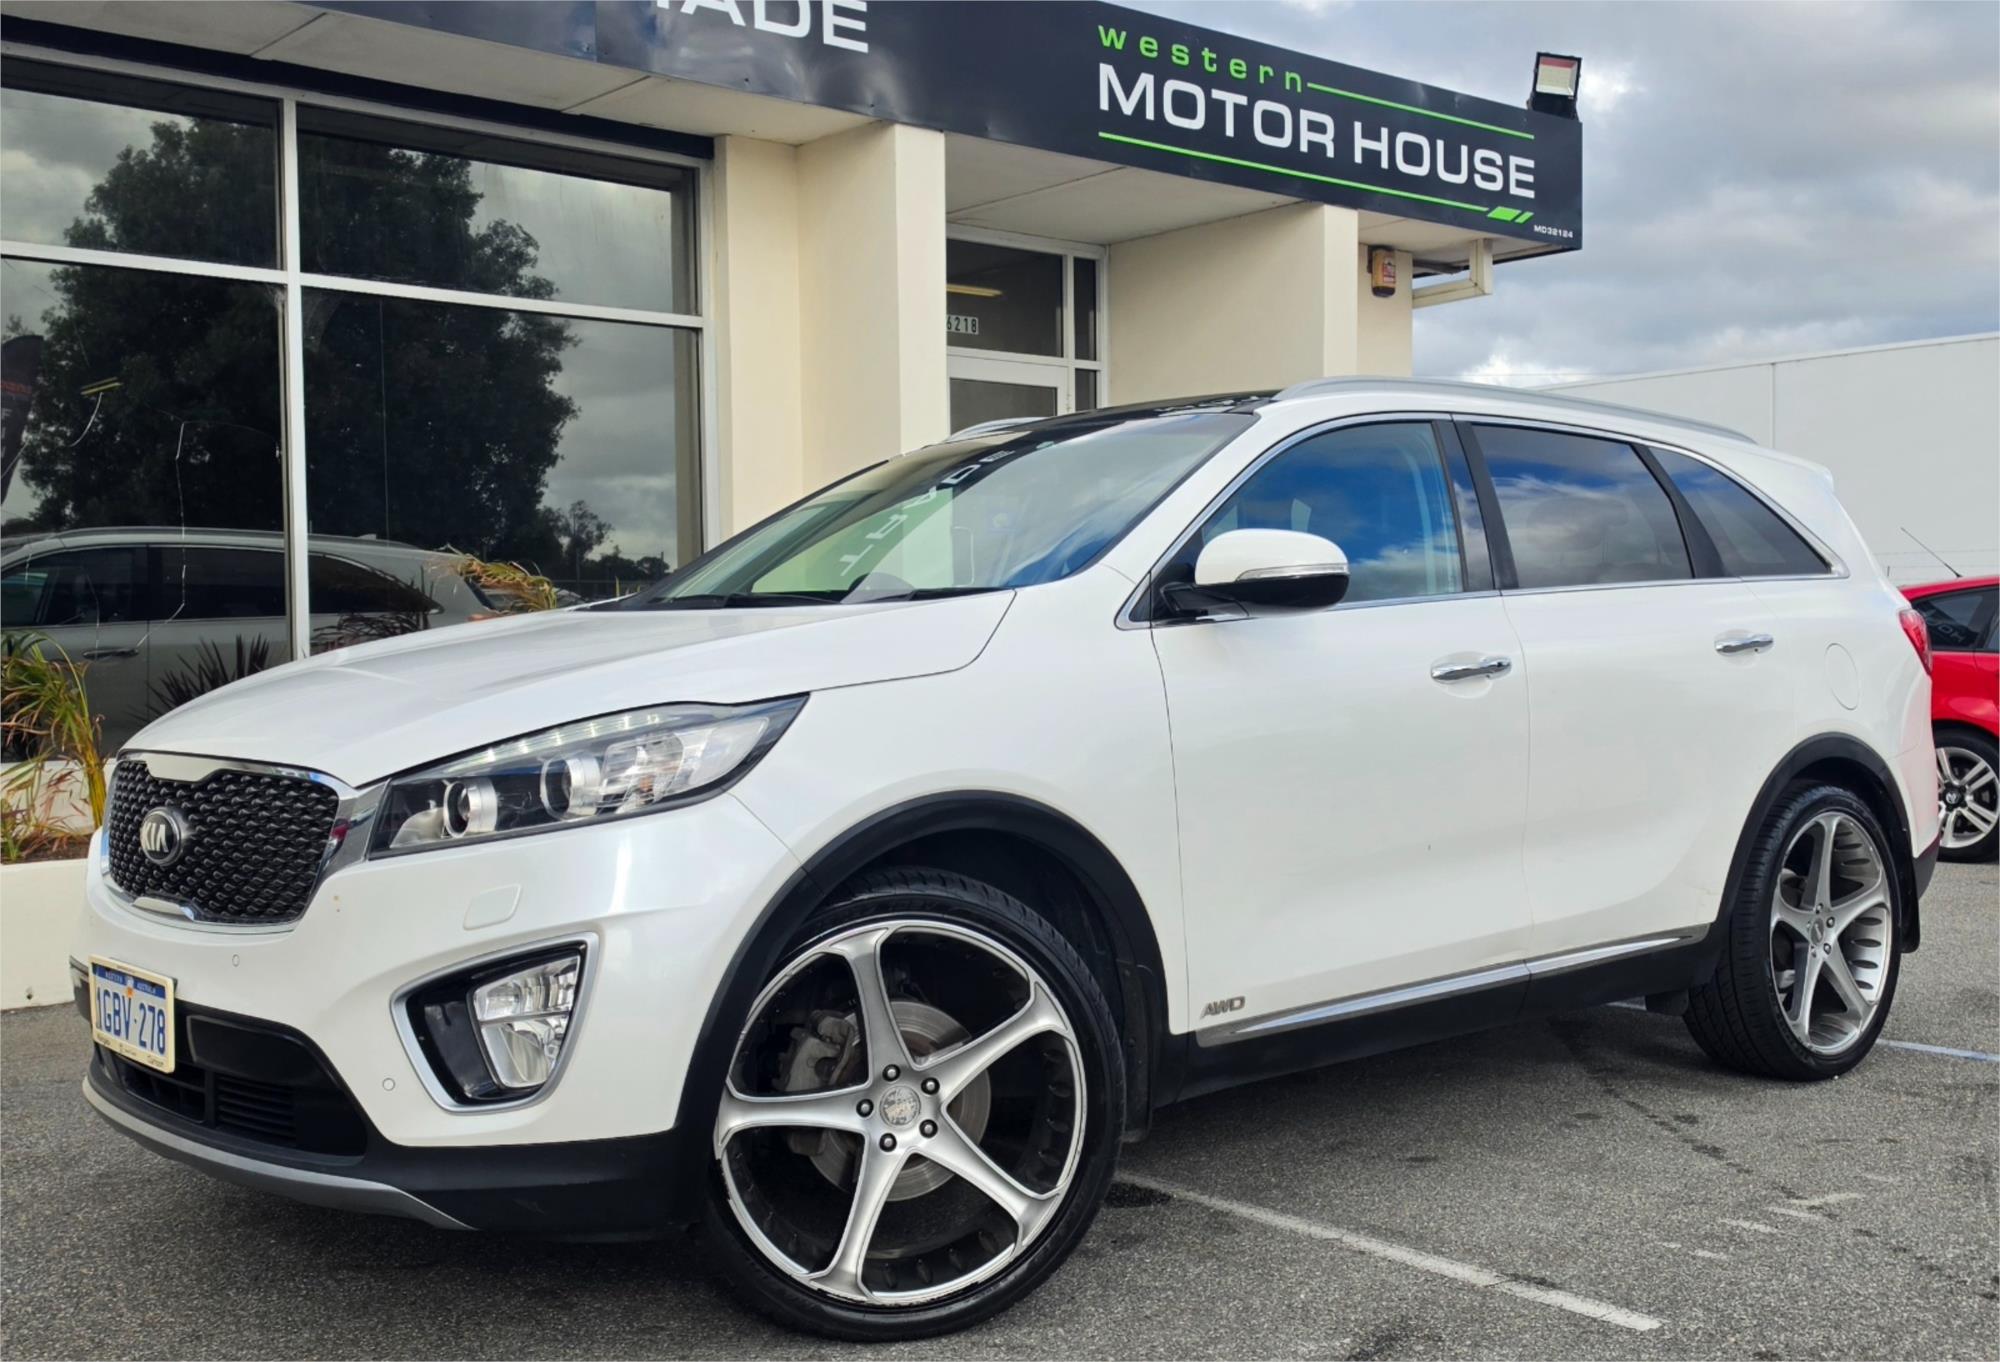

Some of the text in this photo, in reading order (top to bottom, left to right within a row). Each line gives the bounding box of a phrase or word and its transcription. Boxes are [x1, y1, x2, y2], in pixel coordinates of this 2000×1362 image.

[1098, 25, 1302, 93] western
[1099, 62, 1535, 199] MOTOR HOUSE
[946, 315, 977, 333] 6218
[1200, 996, 1246, 1019] AWD
